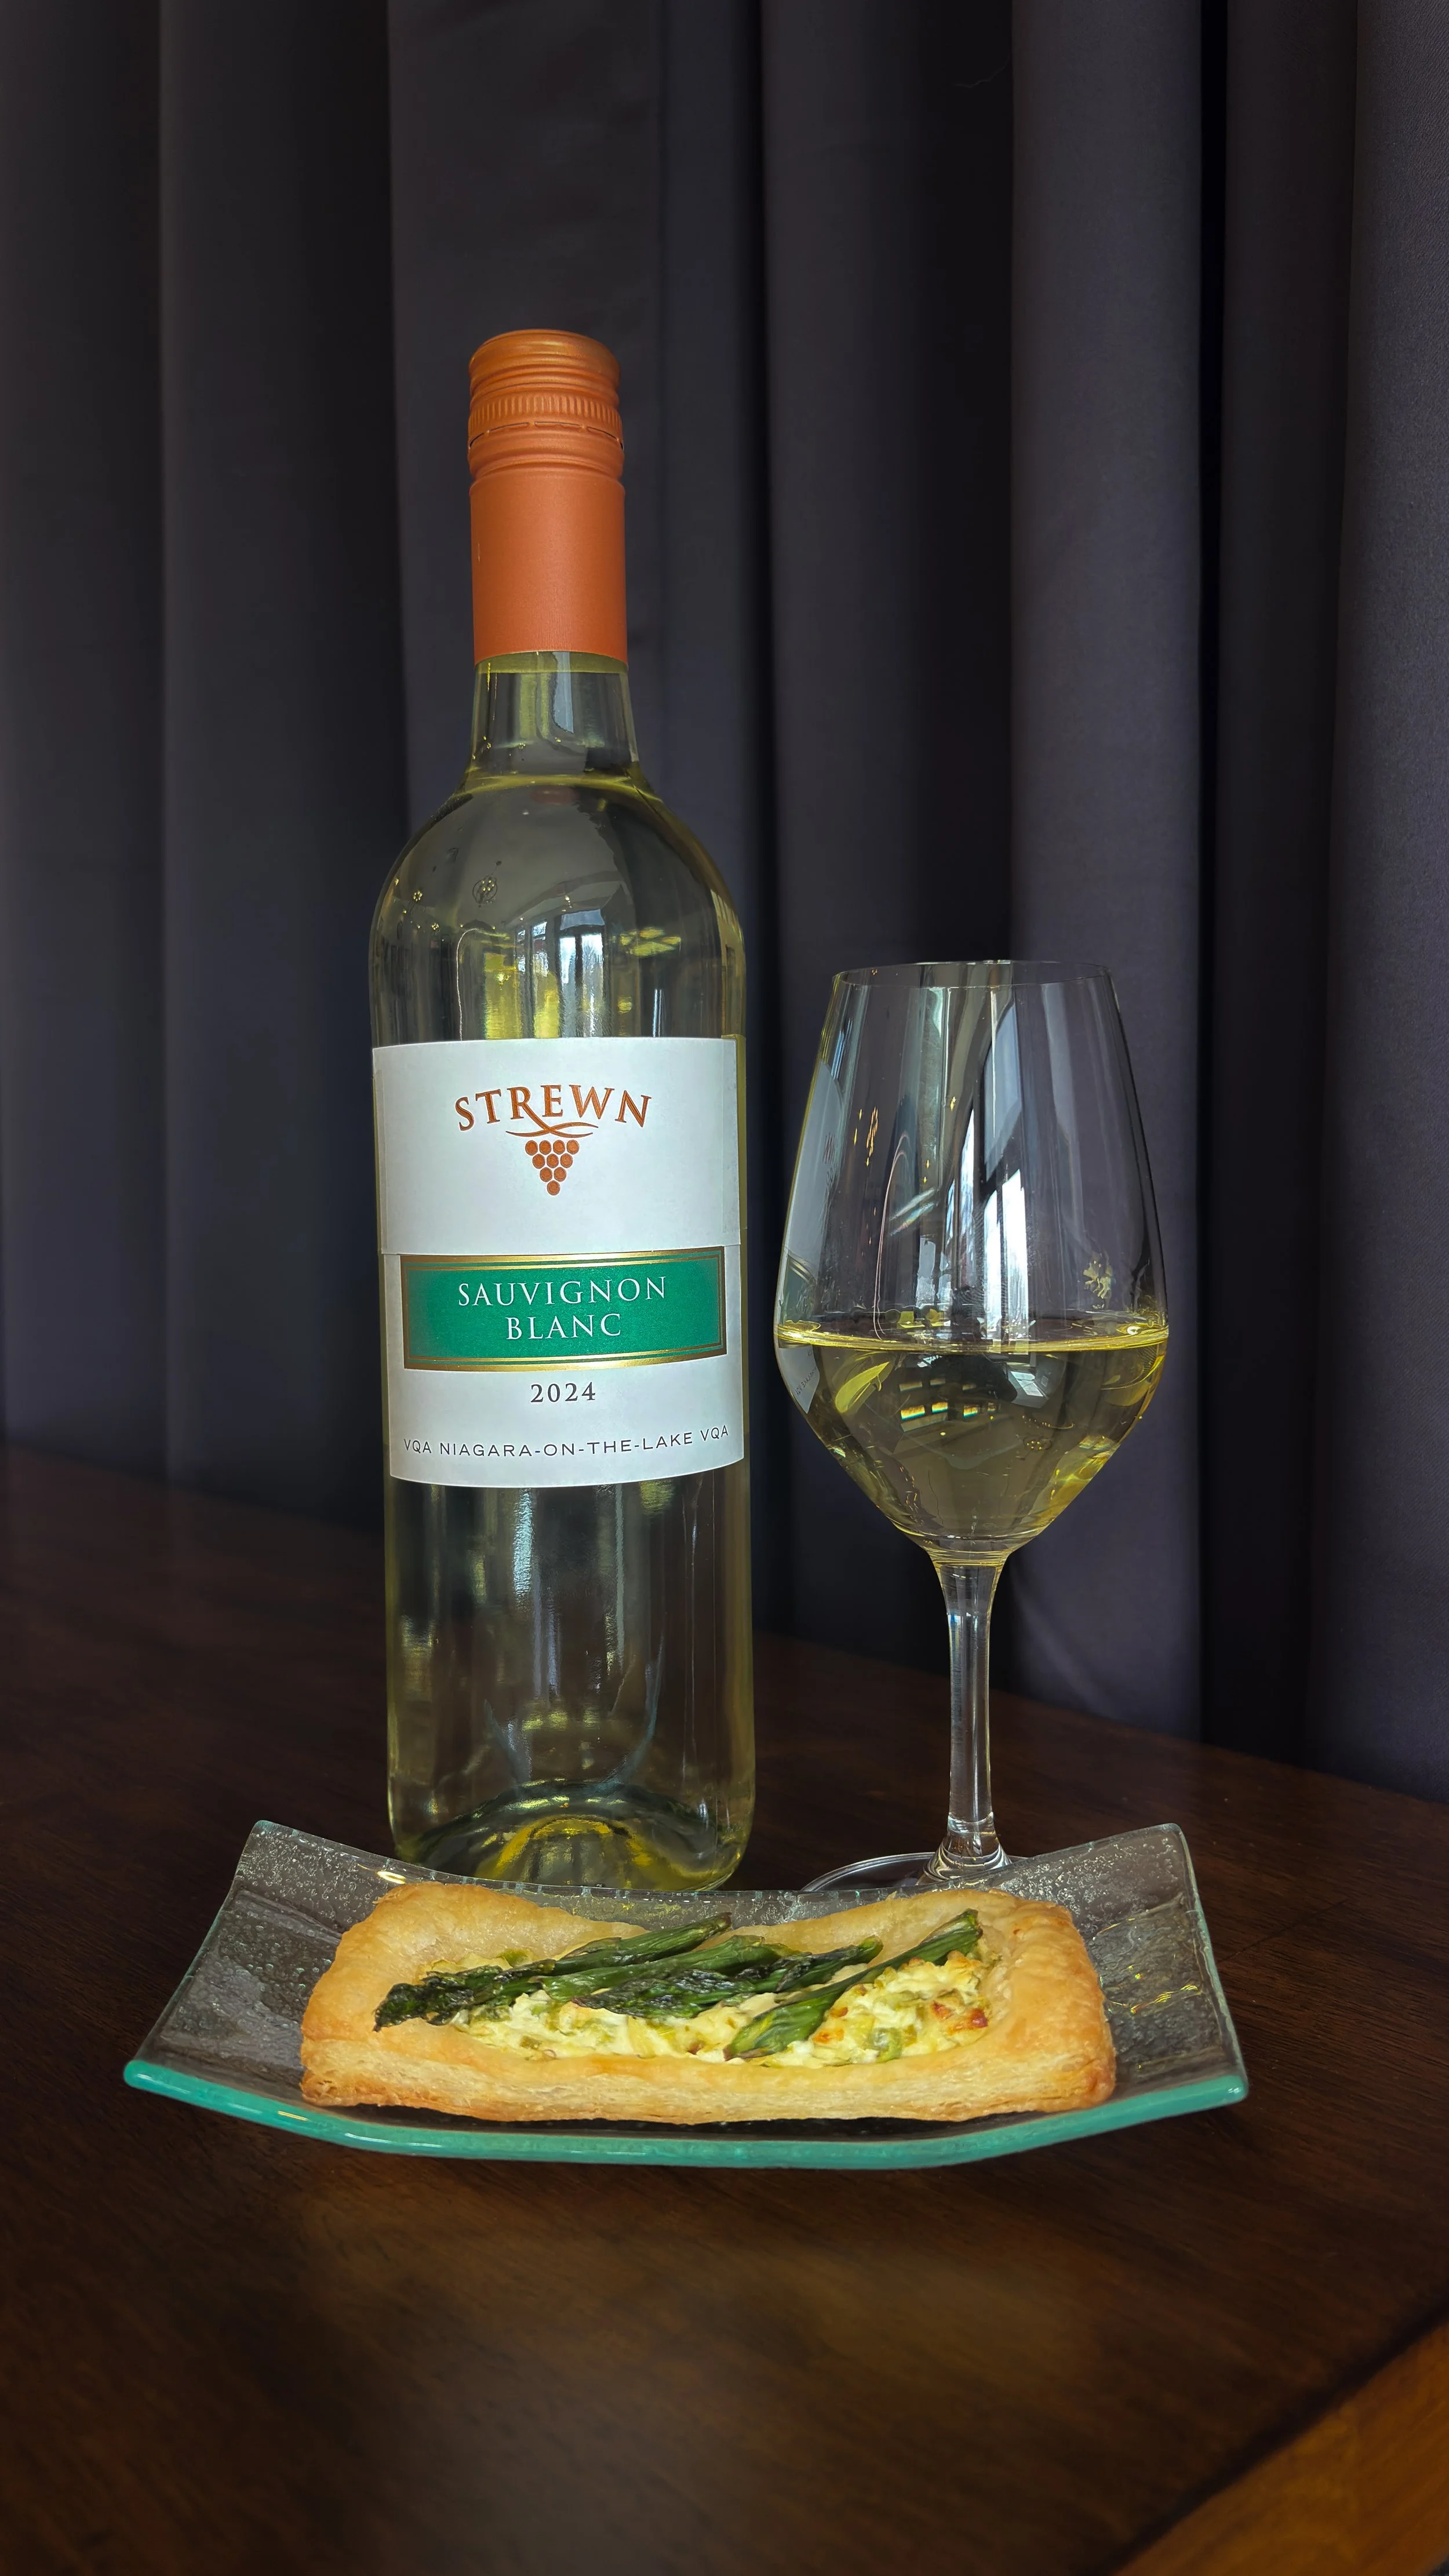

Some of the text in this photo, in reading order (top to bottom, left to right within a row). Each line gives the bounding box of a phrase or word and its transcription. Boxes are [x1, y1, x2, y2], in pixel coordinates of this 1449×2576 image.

[455, 1084, 651, 1138] STREWN
[458, 1276, 667, 1307] SAUVIGNON
[505, 1313, 621, 1340] BLANC
[530, 1381, 596, 1403] 2024
[403, 1424, 729, 1457] VQA NIAGARA-ON-THE-LAKE VQA
